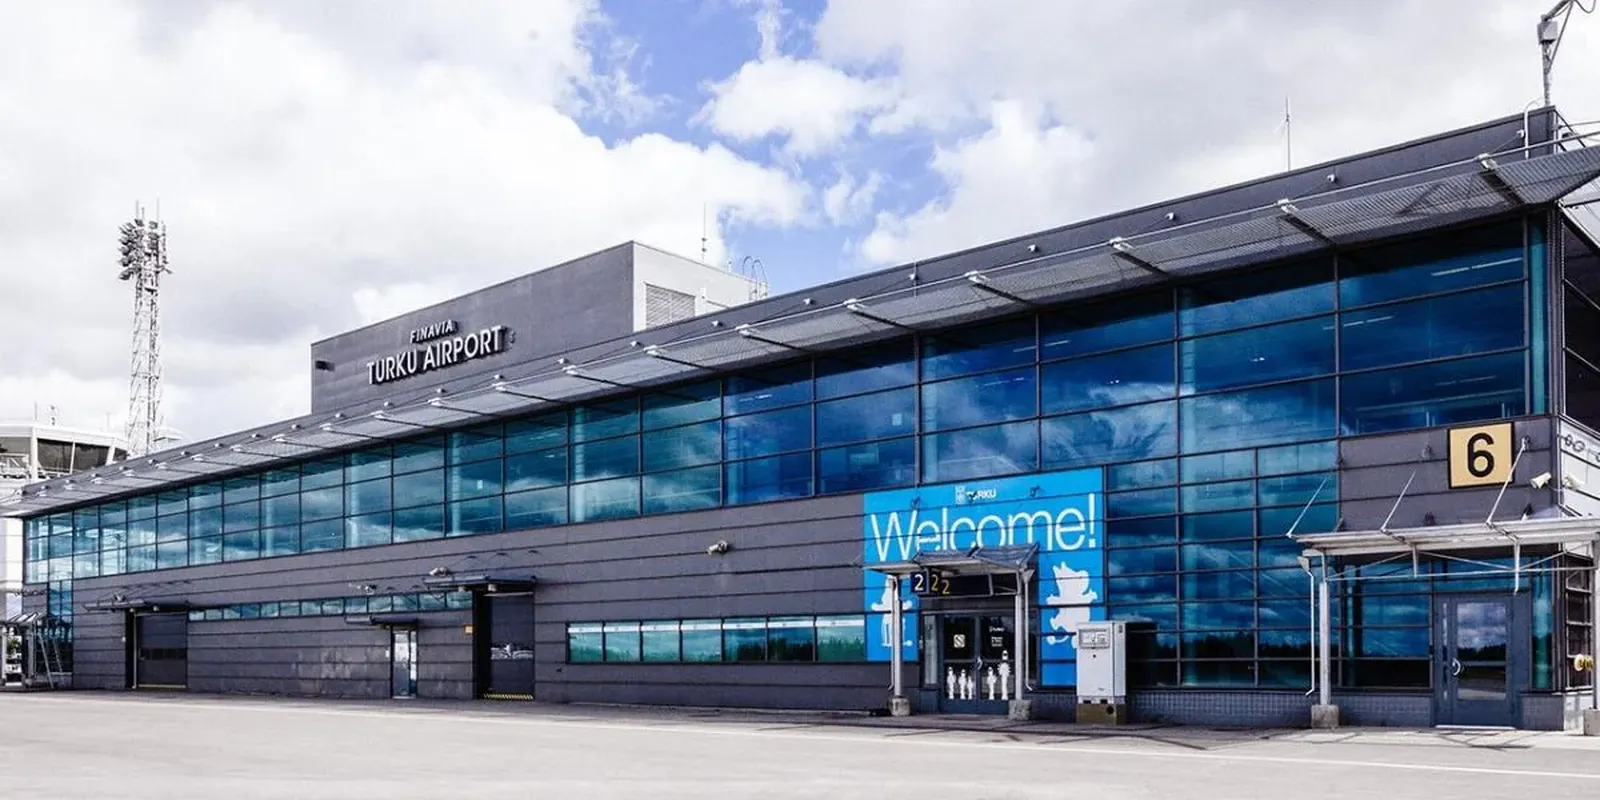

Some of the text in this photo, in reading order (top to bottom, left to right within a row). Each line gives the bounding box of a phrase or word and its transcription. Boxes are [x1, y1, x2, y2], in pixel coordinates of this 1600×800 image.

[409, 319, 453, 344] FINAVIA
[366, 325, 501, 385] TURKU AIRPORT
[1467, 432, 1495, 478] 6
[870, 493, 1096, 562] Welcome!
[914, 573, 924, 591] 2
[931, 573, 939, 591] 2
[941, 579, 950, 595] 2
